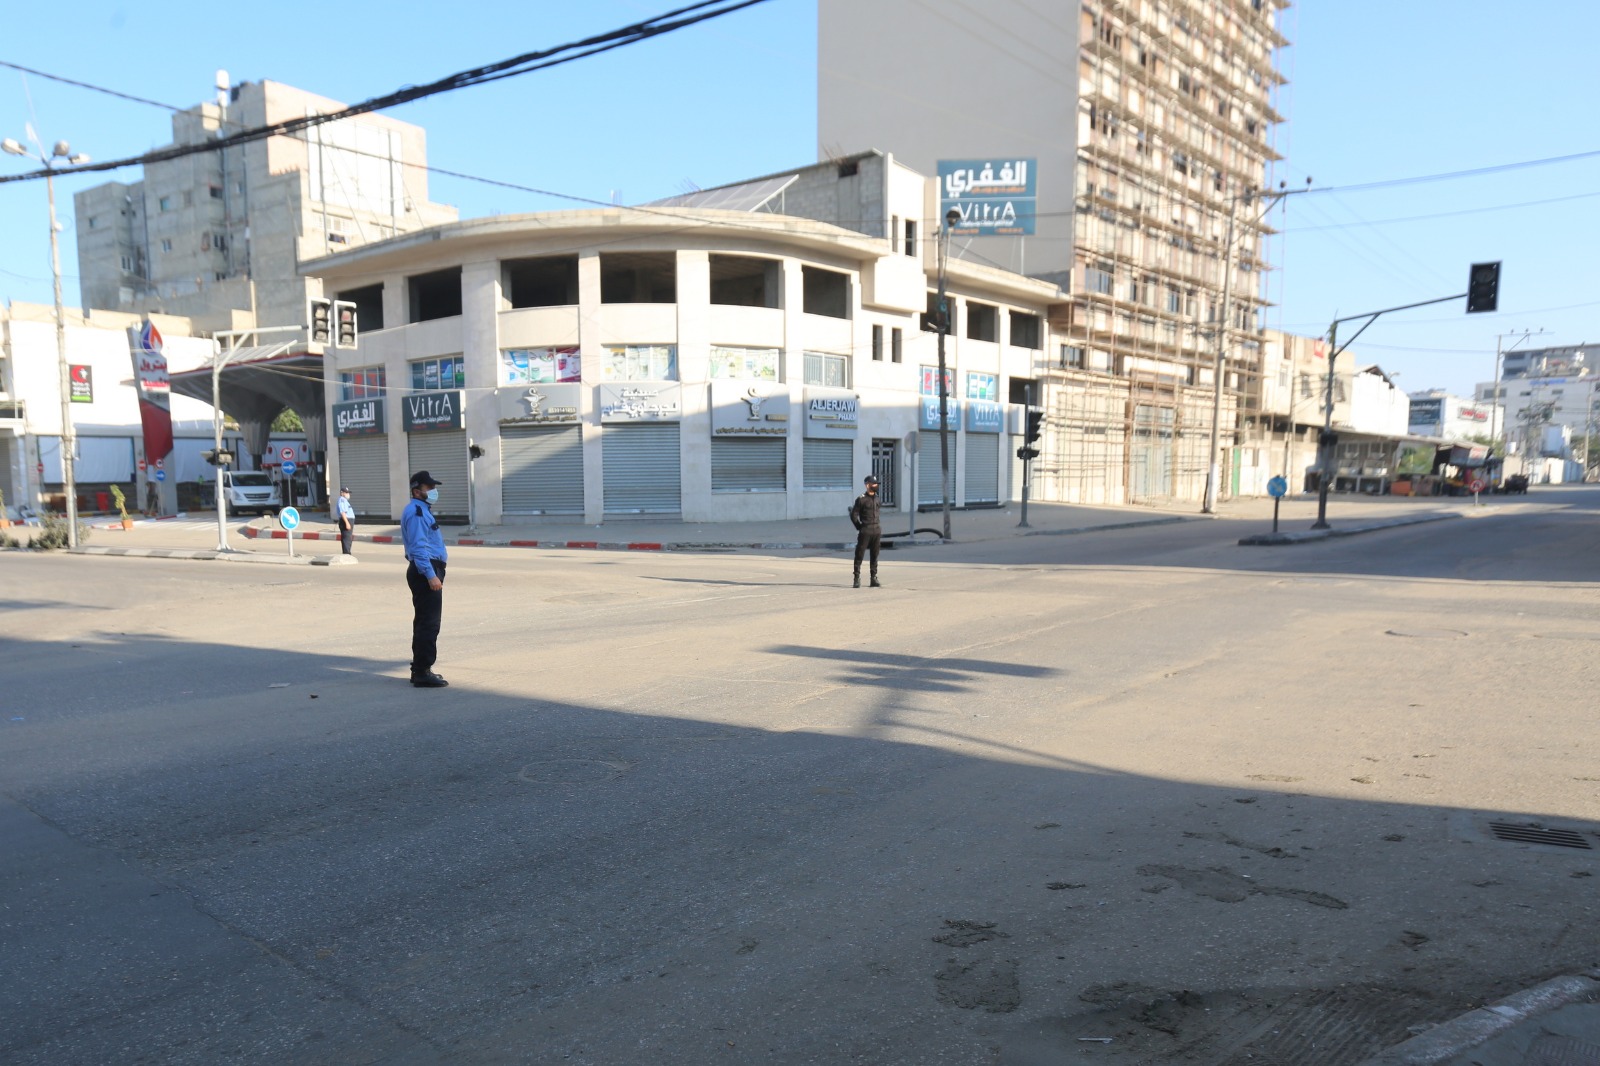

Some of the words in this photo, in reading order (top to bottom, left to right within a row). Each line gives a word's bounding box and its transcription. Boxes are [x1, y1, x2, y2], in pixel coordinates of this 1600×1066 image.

[946, 161, 1027, 198] الغفري
[958, 201, 1016, 221] VitrA
[337, 402, 375, 432] الغفري
[409, 394, 453, 418] VitrA
[811, 400, 857, 412] ALJERJAWI
[973, 402, 1000, 421] VitrA
